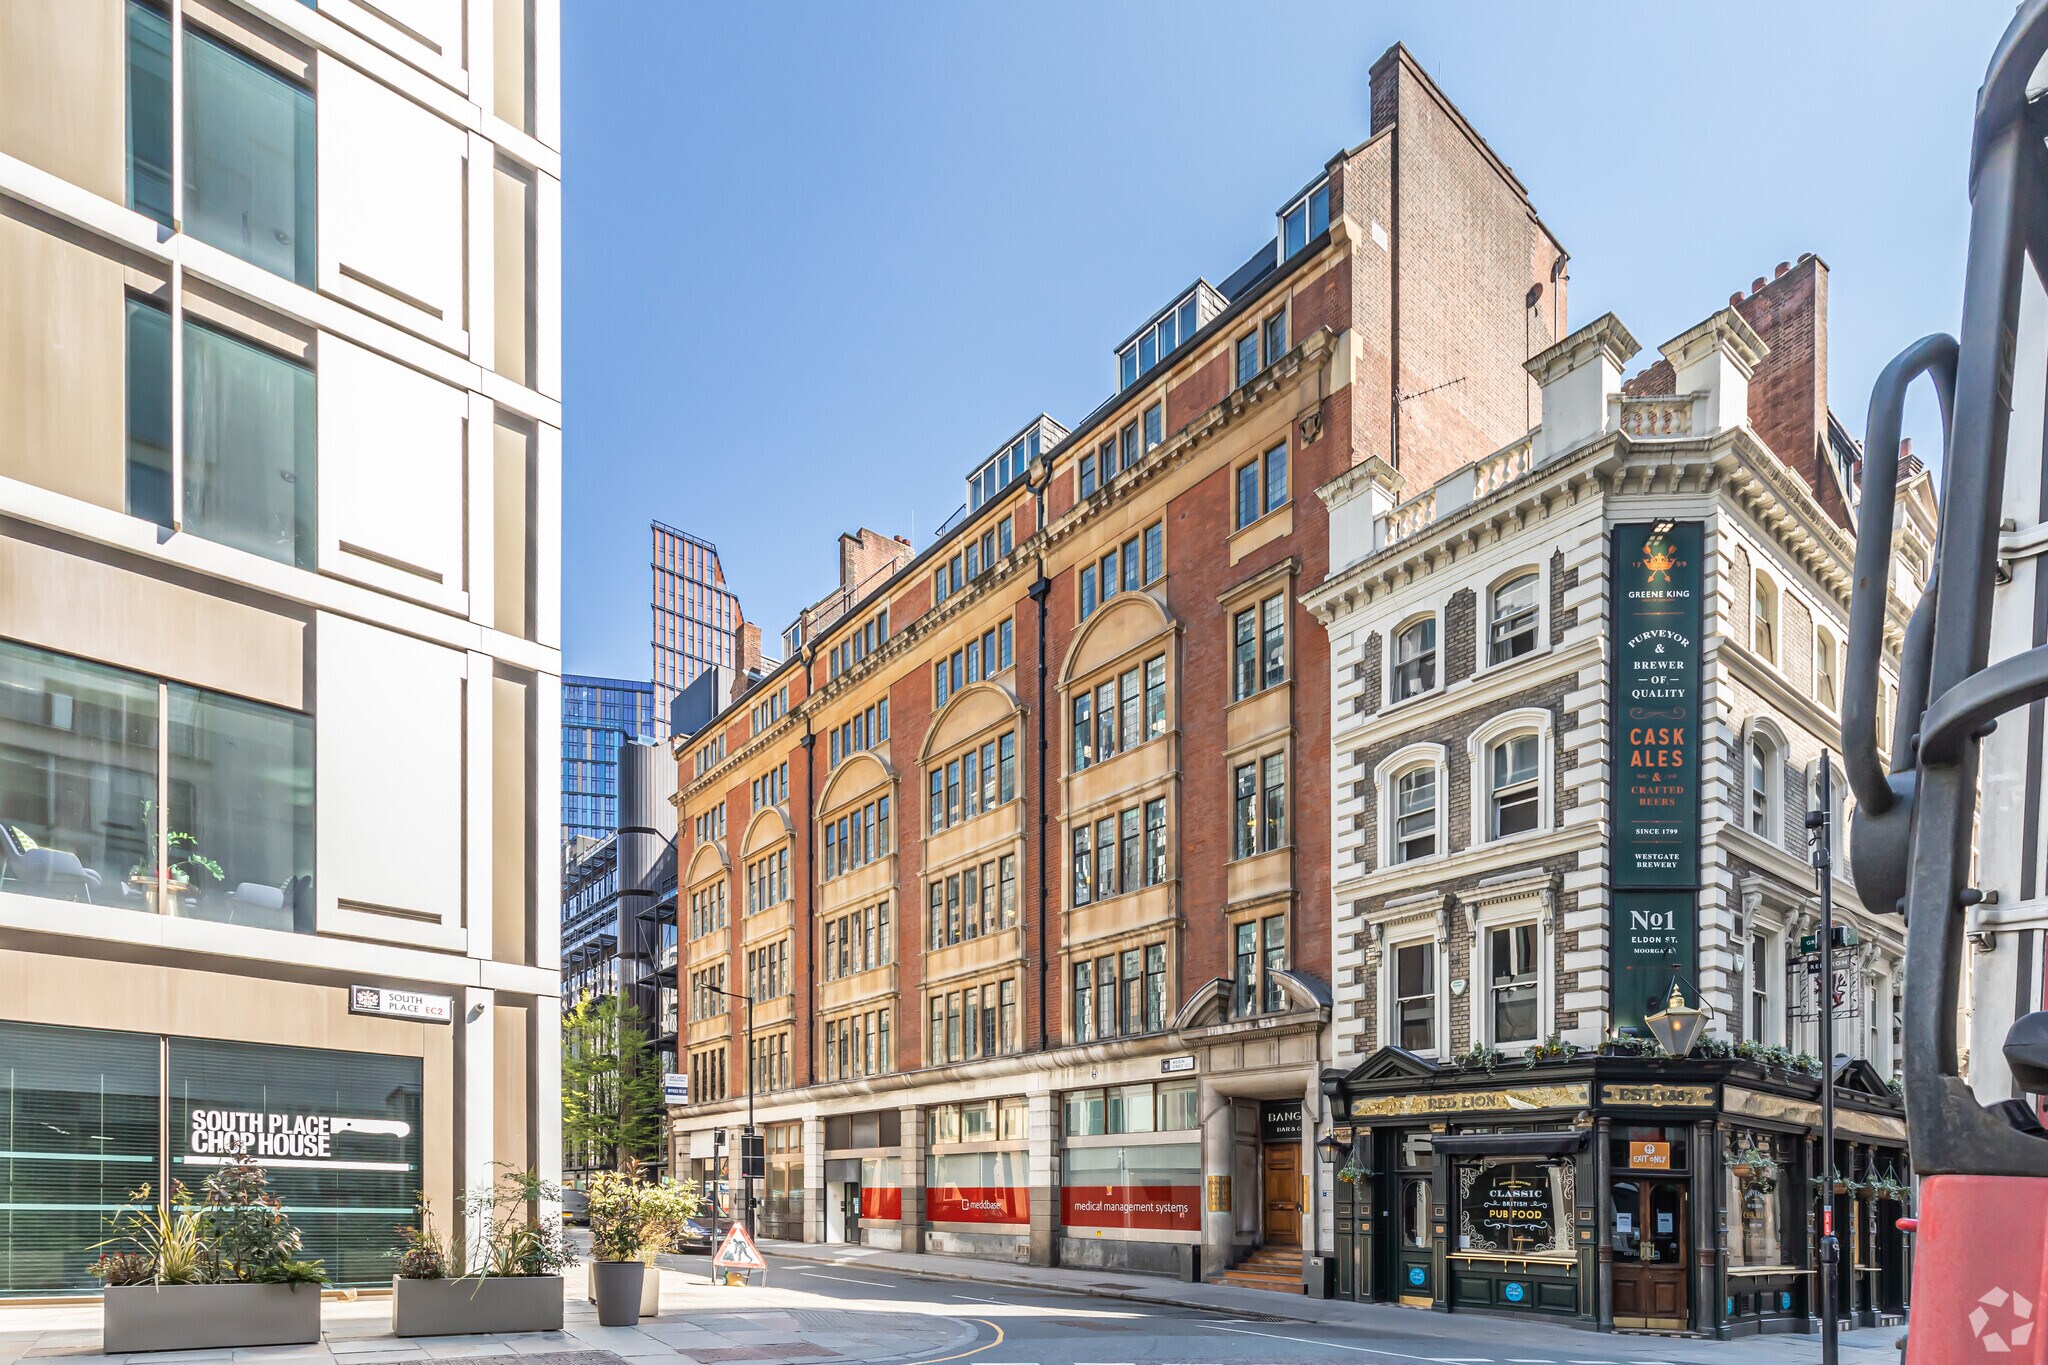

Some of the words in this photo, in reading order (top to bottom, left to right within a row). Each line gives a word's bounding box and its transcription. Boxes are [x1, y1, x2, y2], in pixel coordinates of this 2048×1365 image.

[1666, 590, 1690, 598] KING
[1628, 629, 1690, 648] PURVEYOR
[1655, 643, 1665, 653] &
[1633, 661, 1684, 670] BREWER
[1651, 675, 1667, 684] OF
[1631, 689, 1685, 699] QUALITY
[1630, 728, 1684, 745] CASK
[1630, 750, 1683, 767] ALES
[1652, 772, 1661, 782] &
[1631, 786, 1684, 794] CRAFTED
[1639, 798, 1675, 806] BEERS
[388, 993, 423, 1005] SOUTH
[388, 1002, 419, 1013] PLACE
[425, 1006, 443, 1016] EC2
[1428, 1096, 1457, 1110] RED
[1461, 1094, 1496, 1109] LION
[192, 1109, 264, 1132] SOUTH
[268, 1114, 331, 1136] PLACE
[191, 1130, 256, 1154] CHOP
[257, 1132, 331, 1157] HOUSE
[1633, 1154, 1649, 1163] EXIT
[1489, 1189, 1542, 1198] CLASSIC
[1074, 1200, 1103, 1212] medical
[1103, 1202, 1154, 1214] management
[1155, 1203, 1189, 1215] systems
[1489, 1209, 1509, 1219] PUB
[1511, 1210, 1543, 1219] FOOD
